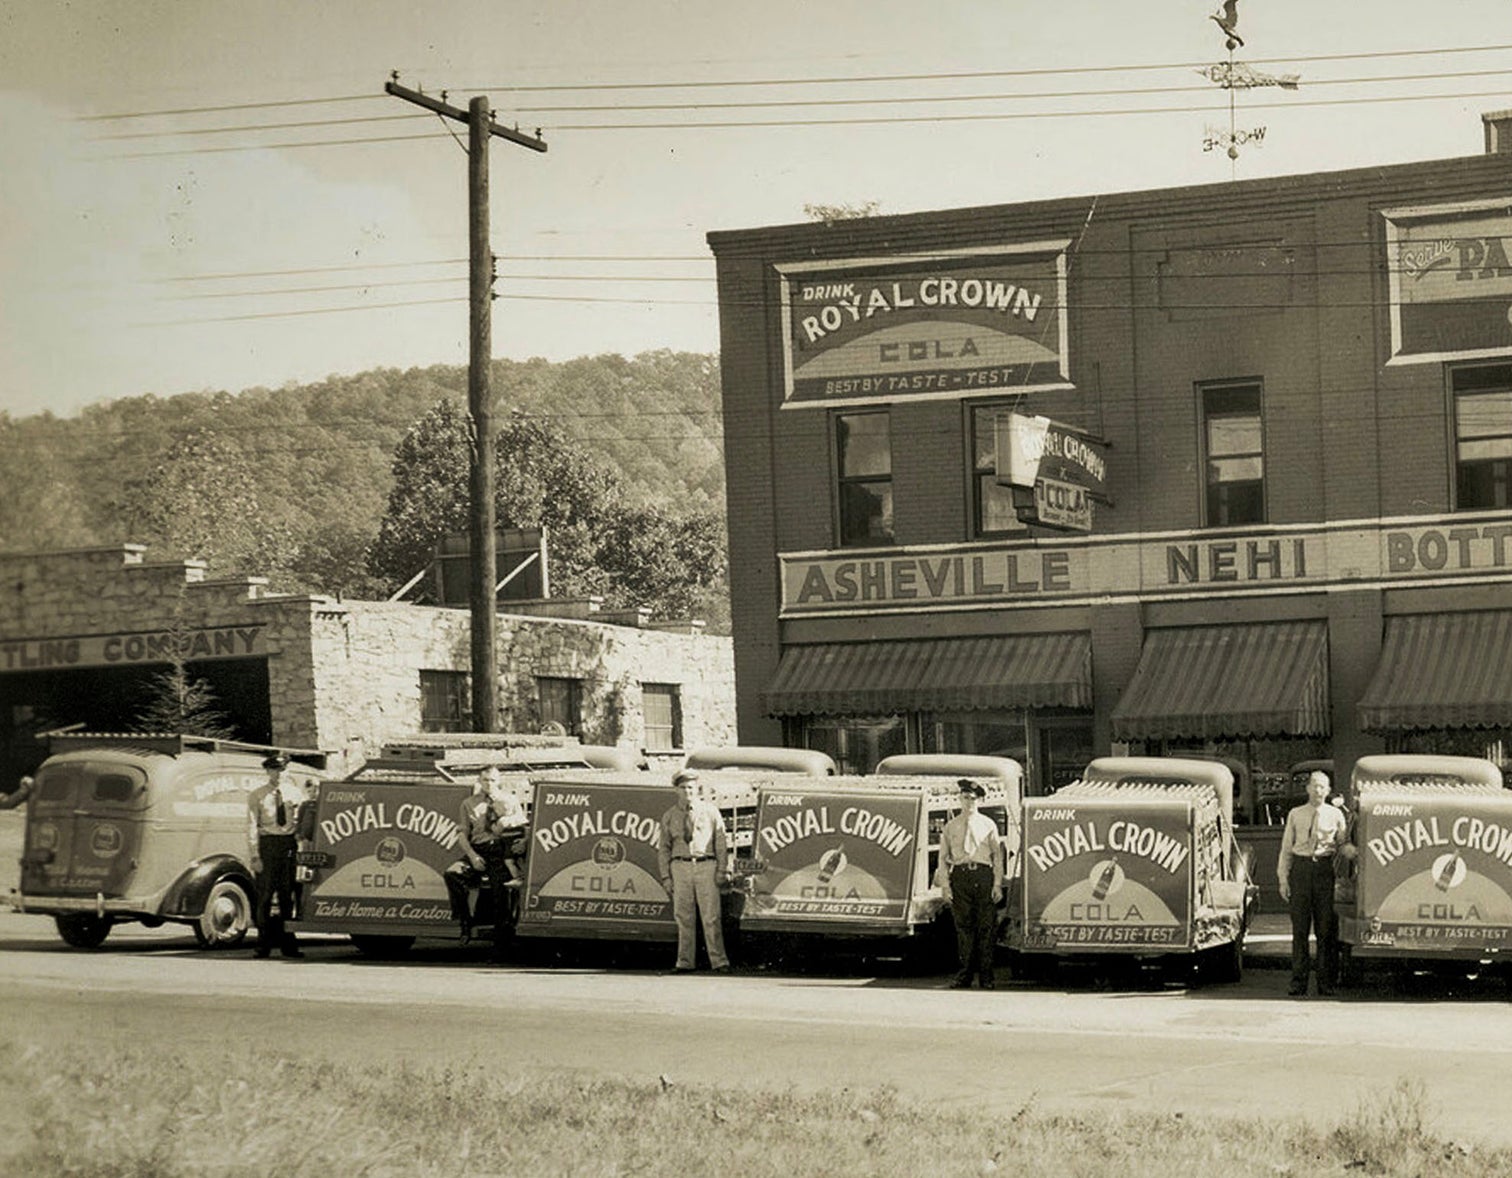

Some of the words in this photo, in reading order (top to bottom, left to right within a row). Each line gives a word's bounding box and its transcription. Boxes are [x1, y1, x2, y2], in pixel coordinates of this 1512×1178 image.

[803, 283, 855, 300] DRINK
[802, 283, 915, 343] ROYAL
[920, 277, 1041, 321] CROWN
[880, 337, 980, 363] COLA
[797, 552, 1070, 602] ASHEVILLE
[1166, 538, 1306, 584] NEHI
[545, 793, 591, 806] DRINK
[767, 795, 803, 806] DRINK
[1033, 809, 1076, 821] DRINK
[1373, 804, 1413, 817] DRINK
[320, 803, 392, 845] ROYAL
[396, 803, 461, 850] CROWN
[536, 810, 610, 853] ROYAL
[611, 810, 661, 850] CRO
[760, 807, 835, 853] ROYAL
[840, 807, 913, 857] CROWN
[1028, 821, 1105, 873] ROYAL
[1108, 821, 1189, 874] CROWN
[1368, 817, 1449, 867] ROYAL
[361, 874, 415, 889] COLA
[571, 876, 636, 894] COLA
[801, 886, 861, 901] COLA
[315, 901, 348, 917] Take
[346, 902, 384, 918] Home
[385, 906, 397, 918] a
[399, 903, 452, 920] Carton
[554, 901, 583, 913] BEST
[585, 902, 599, 913] BY
[779, 902, 805, 911] BEST
[806, 903, 819, 912] BY
[1070, 903, 1144, 921] COLA
[1418, 903, 1481, 920] COLA
[1079, 927, 1096, 941] BY
[1397, 927, 1422, 938] BEST
[1426, 927, 1440, 938] BY
